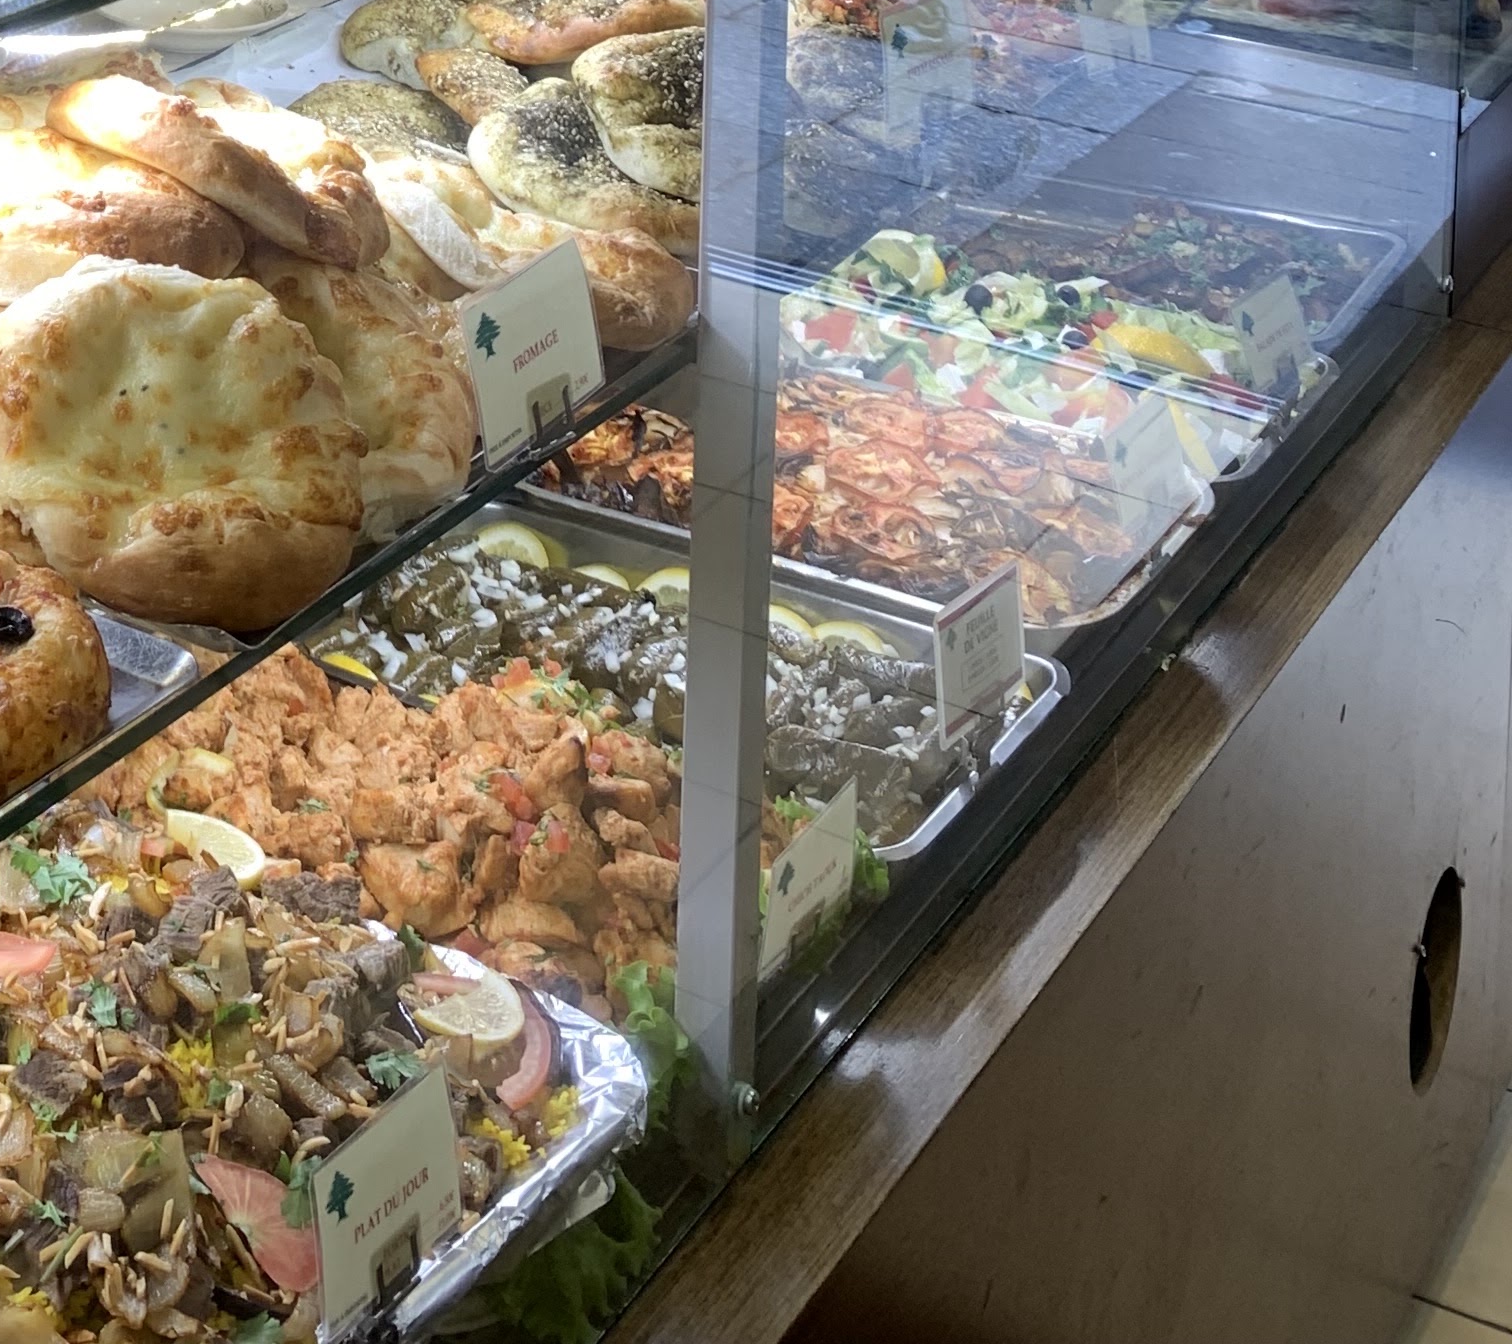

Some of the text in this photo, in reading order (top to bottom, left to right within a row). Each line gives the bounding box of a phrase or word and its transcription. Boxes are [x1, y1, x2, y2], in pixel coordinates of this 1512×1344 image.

[512, 329, 559, 374] FROMAGE
[354, 1208, 381, 1245] PLAT
[384, 1195, 400, 1218] DU
[402, 1167, 429, 1204] JOUR
